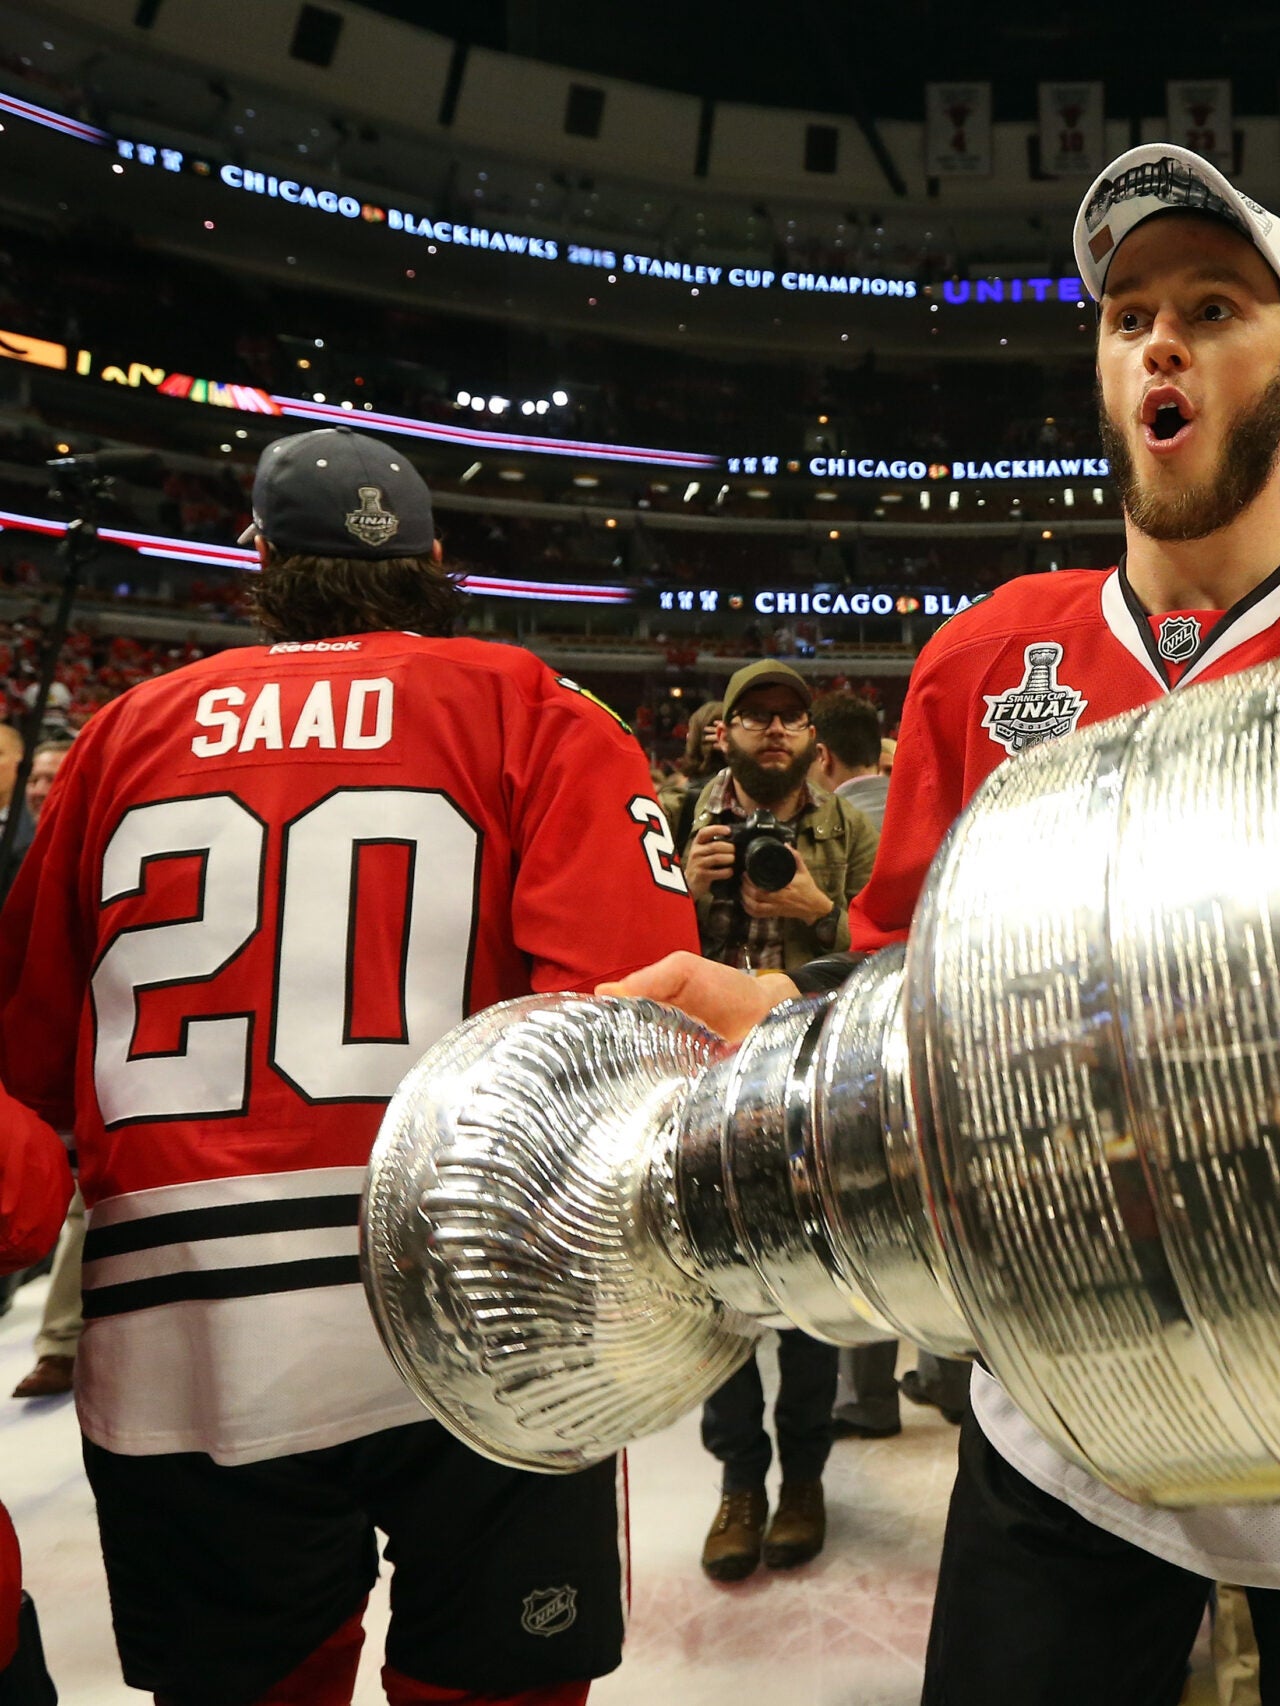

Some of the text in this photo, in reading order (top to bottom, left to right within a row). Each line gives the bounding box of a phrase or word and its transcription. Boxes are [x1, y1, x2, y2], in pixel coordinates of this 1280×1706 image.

[220, 164, 360, 218] CHICAGO
[388, 208, 558, 260] BLACKHAWKS
[622, 253, 722, 285] STANLEY
[729, 268, 775, 289] CUP
[781, 271, 917, 299] CHAMPIONS
[942, 276, 1096, 305] UNITE
[809, 457, 1109, 480] CHICAGO BLACKHAWKS
[350, 516, 393, 525] FINAL
[755, 592, 972, 615] CHICAGO BLA
[269, 641, 362, 655] Reebok
[1166, 628, 1191, 652] NHL
[1006, 692, 1066, 703] STANLEY CUP
[191, 676, 394, 758] SAAD
[993, 699, 1075, 720] FINAL
[92, 787, 482, 1131] 20
